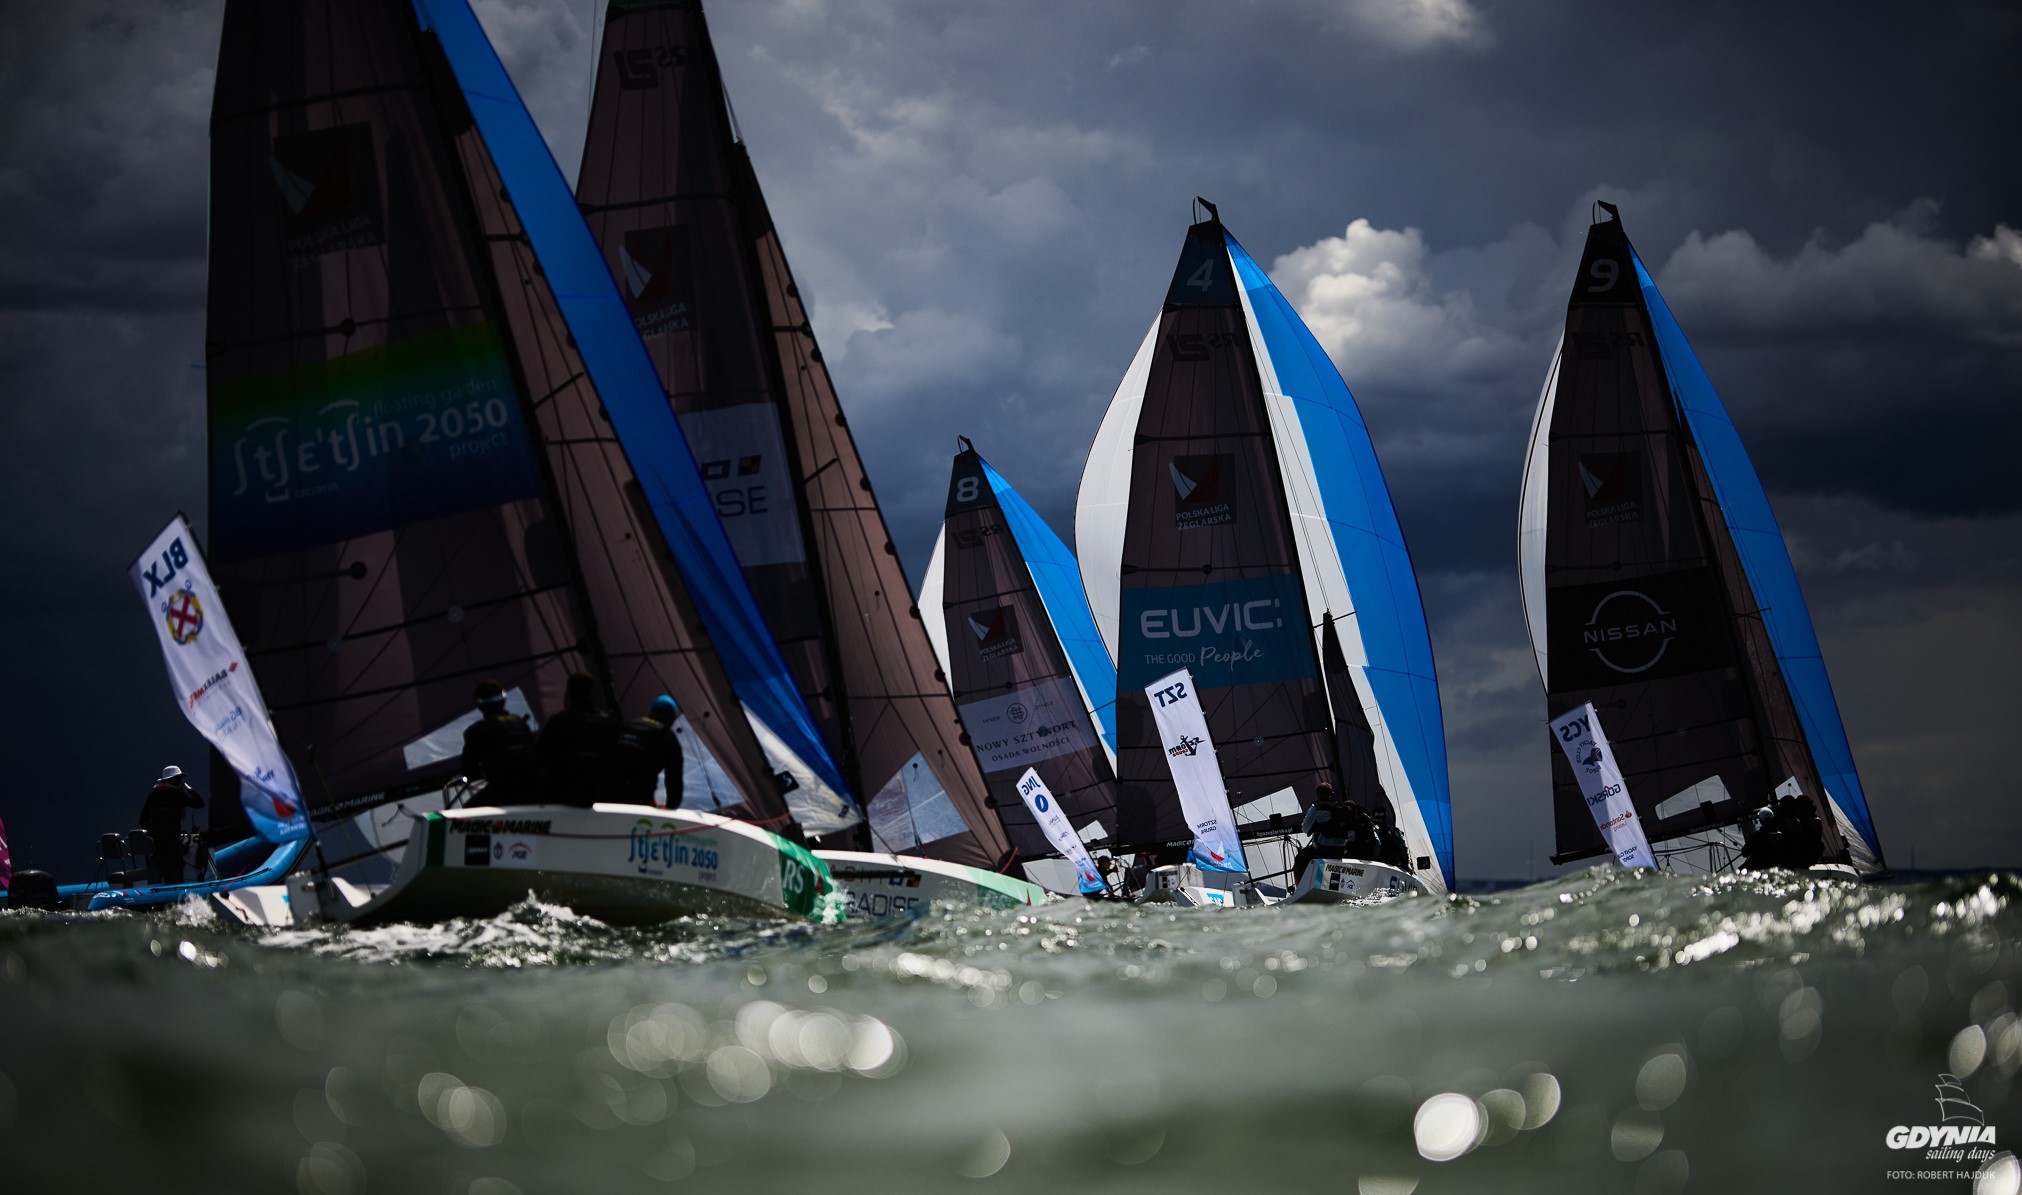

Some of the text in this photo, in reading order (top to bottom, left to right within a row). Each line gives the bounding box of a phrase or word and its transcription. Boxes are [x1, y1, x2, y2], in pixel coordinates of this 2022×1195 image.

[1186, 259, 1214, 292] 4
[1587, 258, 1620, 293] 9
[634, 309, 665, 328] OLSKA
[372, 376, 498, 418] floating garden
[415, 398, 508, 443] 2050
[448, 430, 508, 462] project
[956, 475, 979, 502] 8
[1176, 503, 1230, 521] POLSKA LIGA
[1177, 513, 1232, 530] ŻEGLARSKA
[1587, 501, 1637, 519] POLSKA LIGA
[1583, 618, 1678, 644] NISSAN
[1144, 640, 1264, 672] THE GOOD People
[976, 738, 1009, 753] NOWY
[991, 736, 1071, 762] OSADA WOLNOŚCI
[344, 791, 387, 809] MARINE
[449, 820, 552, 835] MAGIC MARINE
[691, 847, 719, 871] 2050
[1325, 863, 1365, 878] MAGIC MARINE
